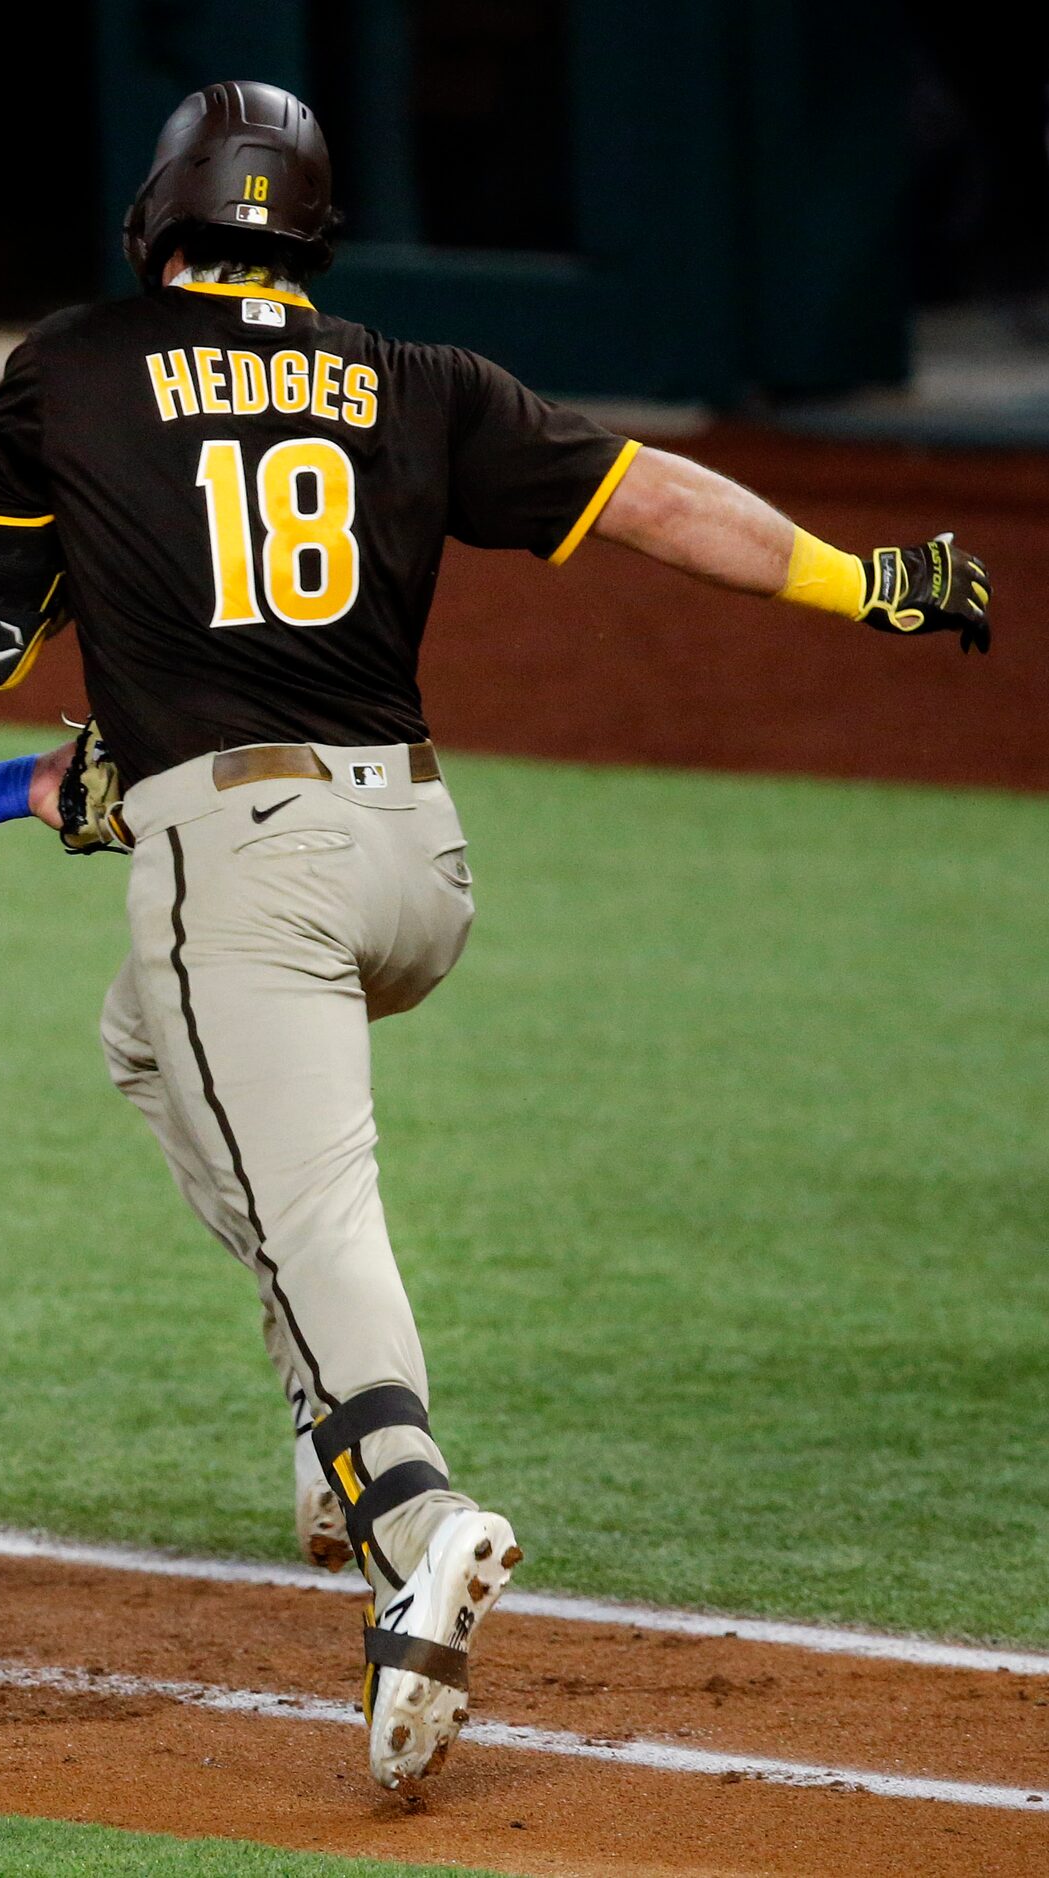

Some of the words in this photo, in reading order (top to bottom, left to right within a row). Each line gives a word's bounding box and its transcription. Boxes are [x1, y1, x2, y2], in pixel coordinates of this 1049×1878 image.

[243, 174, 269, 202] 18
[146, 346, 379, 428] HEDGES
[195, 437, 360, 629] 18
[927, 541, 943, 599] EASTON
